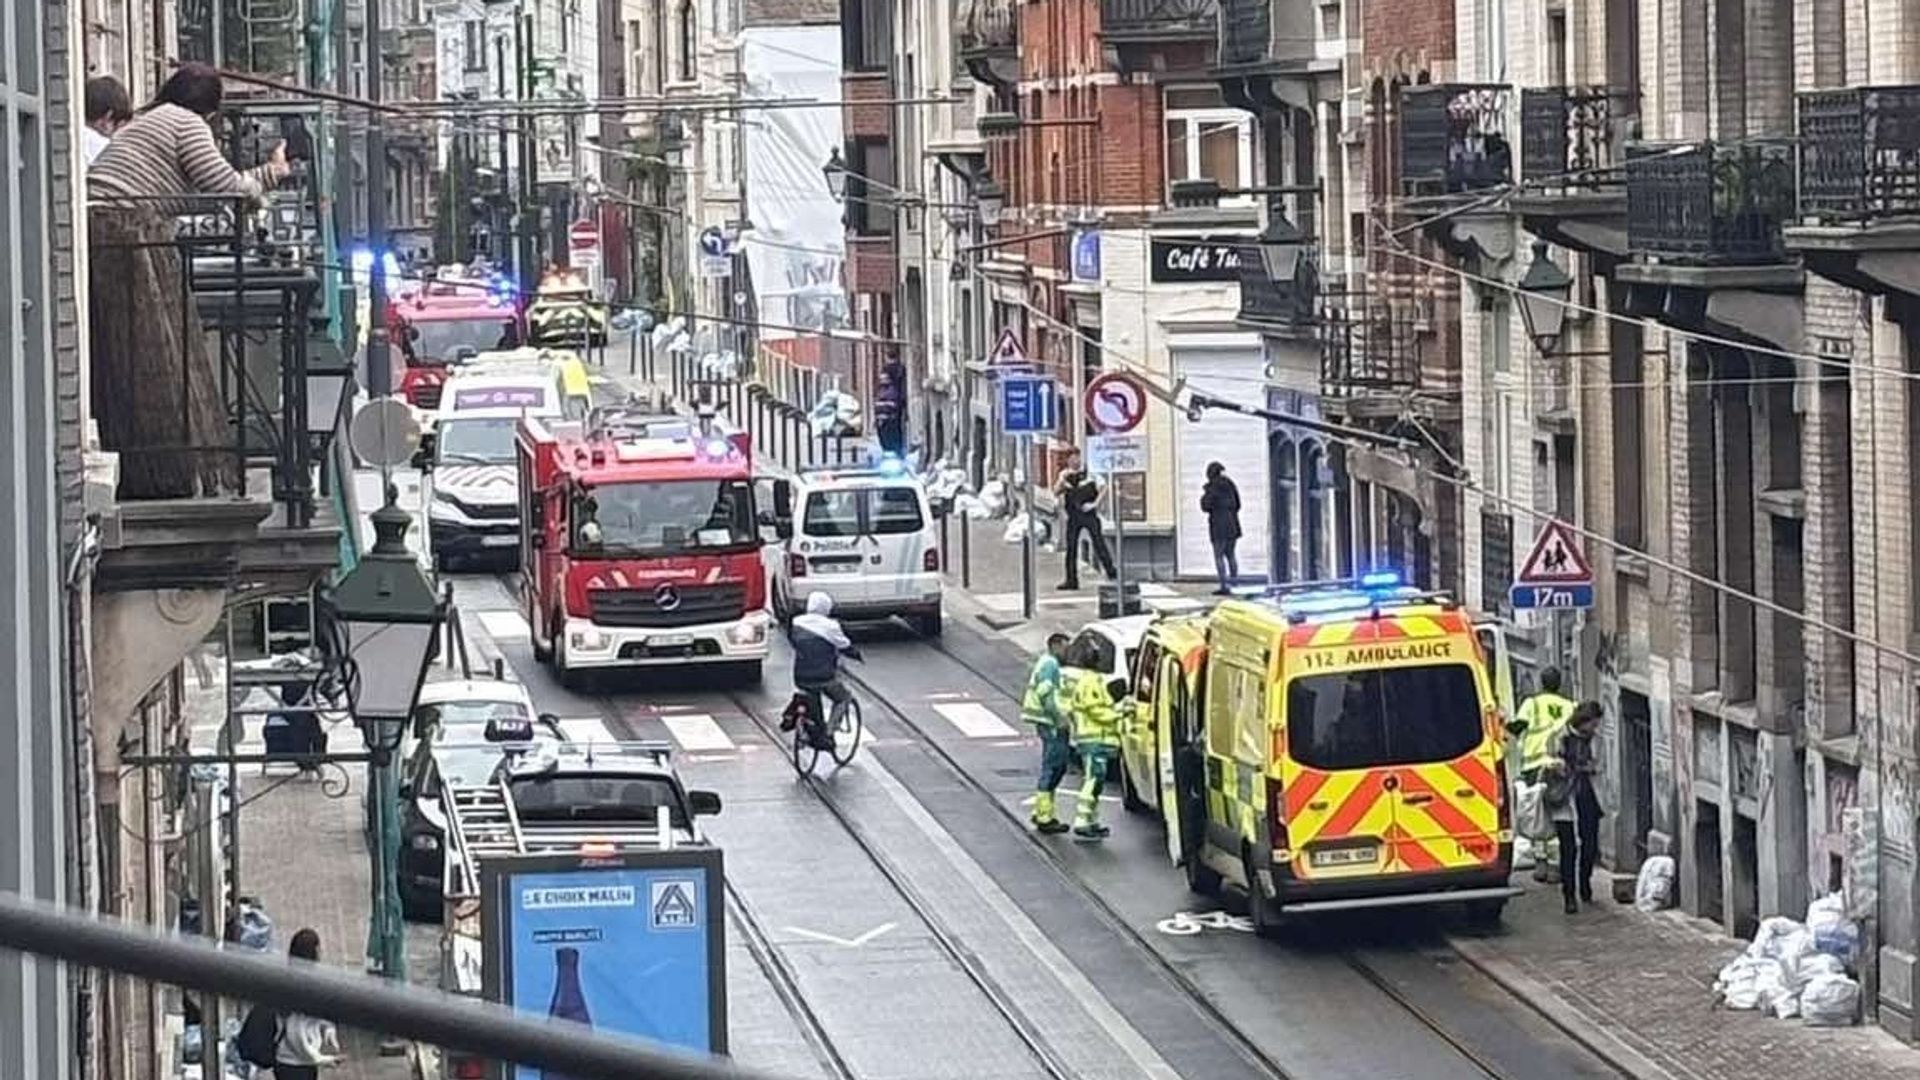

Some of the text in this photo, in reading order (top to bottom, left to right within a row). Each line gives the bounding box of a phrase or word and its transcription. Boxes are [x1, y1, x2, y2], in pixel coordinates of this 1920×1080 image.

[1166, 246, 1210, 272] Café
[1533, 587, 1573, 607] 17m
[1304, 642, 1452, 668] 112 AMBULANCE
[544, 889, 586, 904] CHOIX
[588, 887, 632, 903] MALIN
